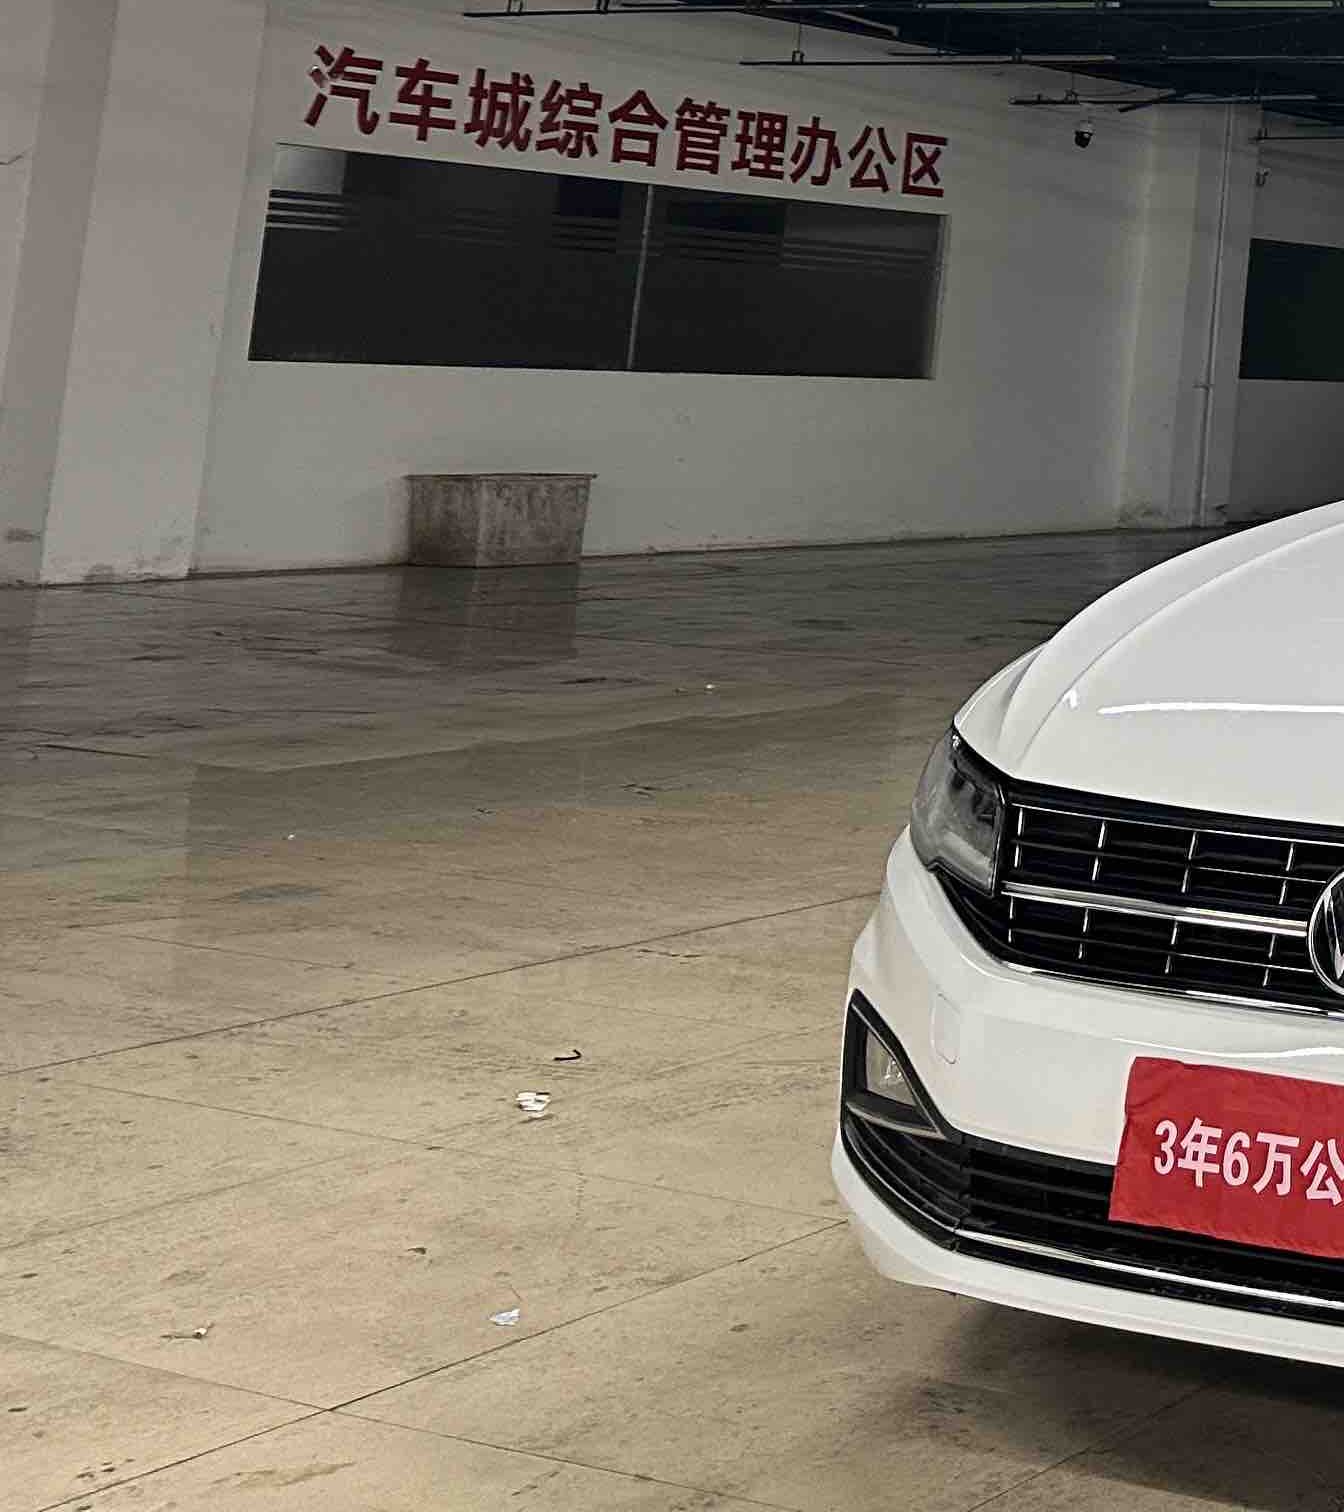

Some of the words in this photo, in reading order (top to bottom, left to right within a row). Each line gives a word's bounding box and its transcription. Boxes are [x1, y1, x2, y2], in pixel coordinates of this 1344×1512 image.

[304, 45, 949, 198] 汽车城综合管理办公区
